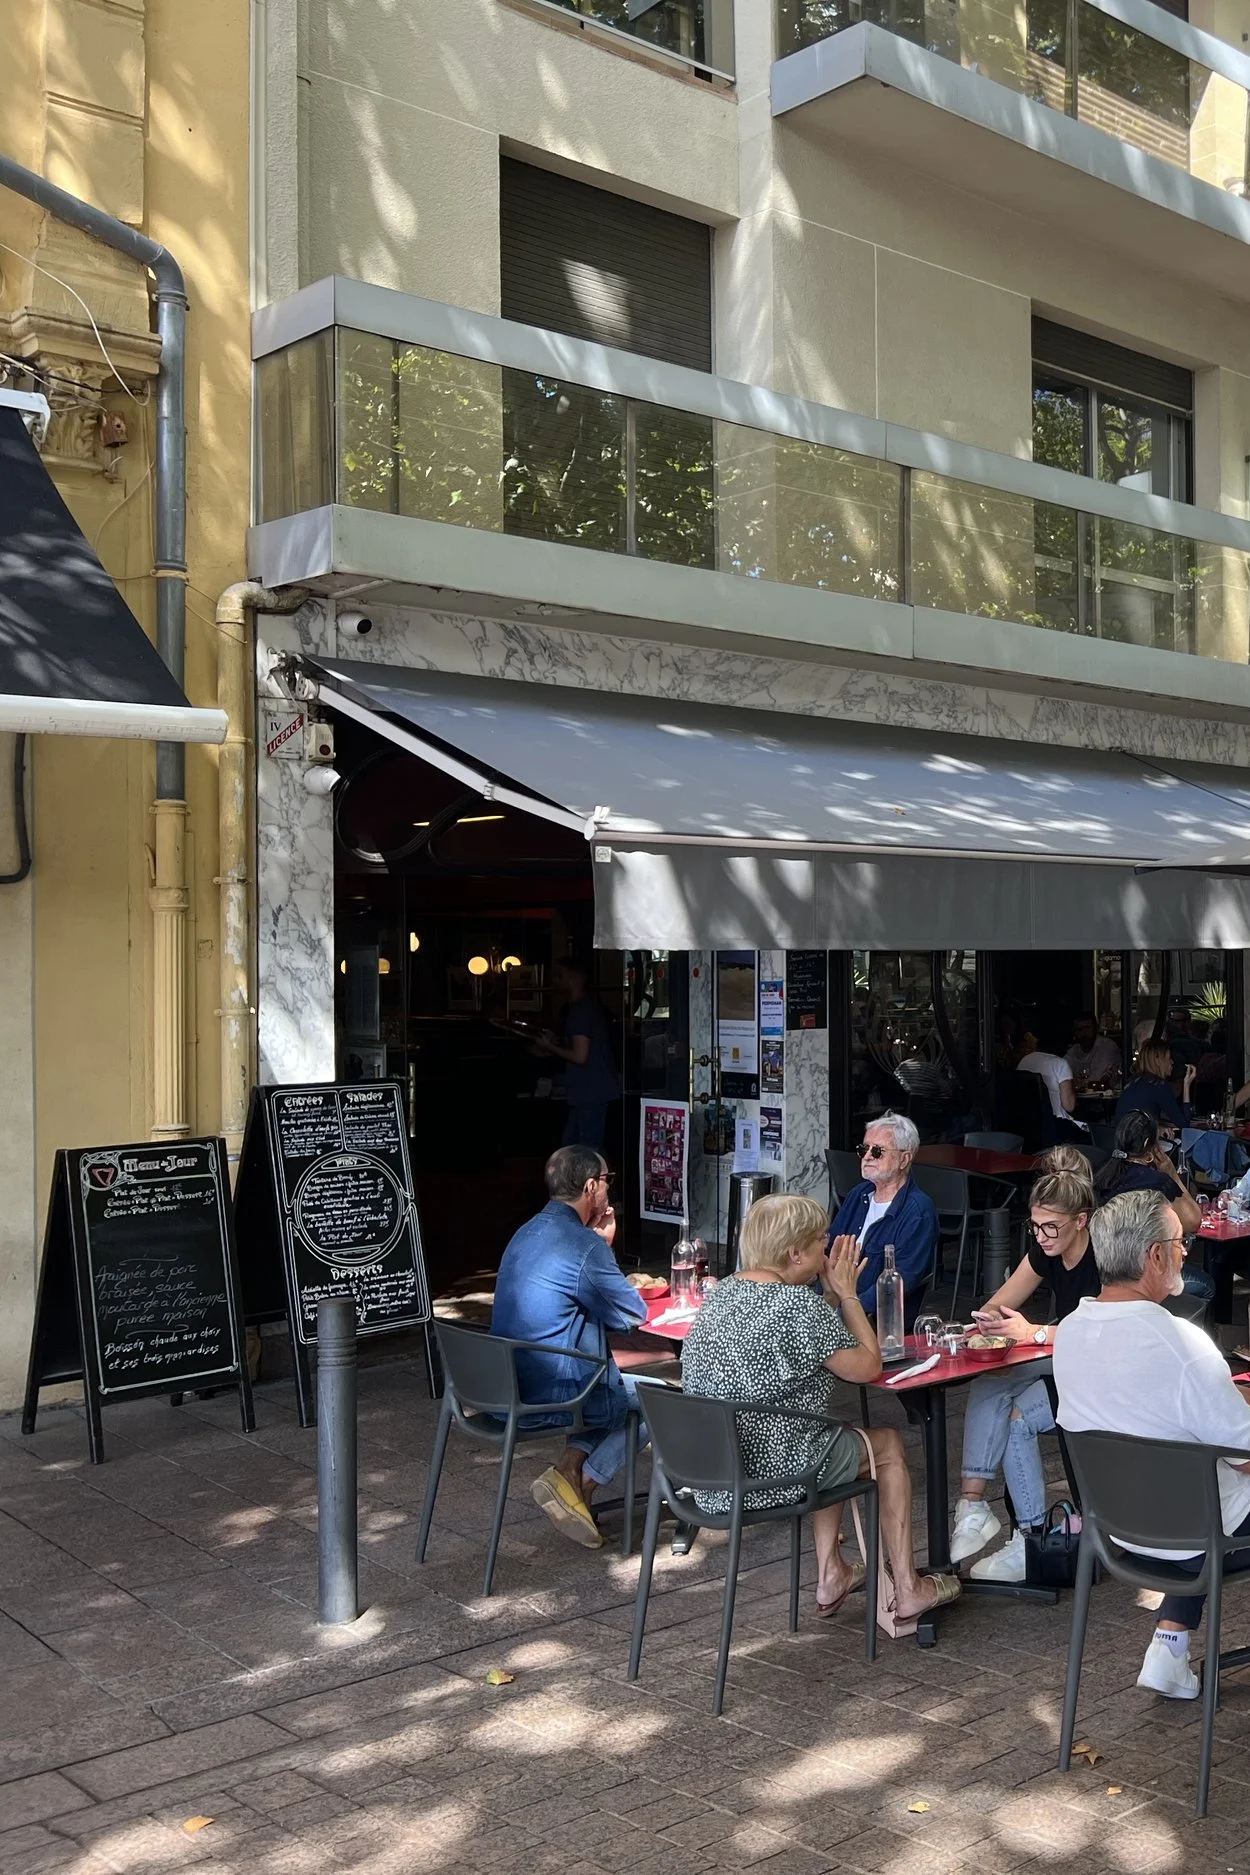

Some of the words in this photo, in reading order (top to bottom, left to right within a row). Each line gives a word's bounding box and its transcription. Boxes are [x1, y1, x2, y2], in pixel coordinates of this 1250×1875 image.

[269, 717, 301, 753] LICENCE
[270, 722, 281, 731] IV
[123, 1158, 161, 1172] Menu
[164, 1155, 198, 1173] Jour
[150, 1263, 164, 1278] de
[167, 1263, 198, 1282] porc
[330, 1264, 383, 1280] Desserts
[155, 1280, 197, 1293] sauce
[113, 1311, 155, 1335] purée
[162, 1307, 208, 1325] maison
[103, 1338, 144, 1359] Boisson
[150, 1332, 178, 1348] chaude
[108, 1358, 119, 1370] et
[121, 1358, 140, 1370] ses
[143, 1352, 163, 1364] trois
